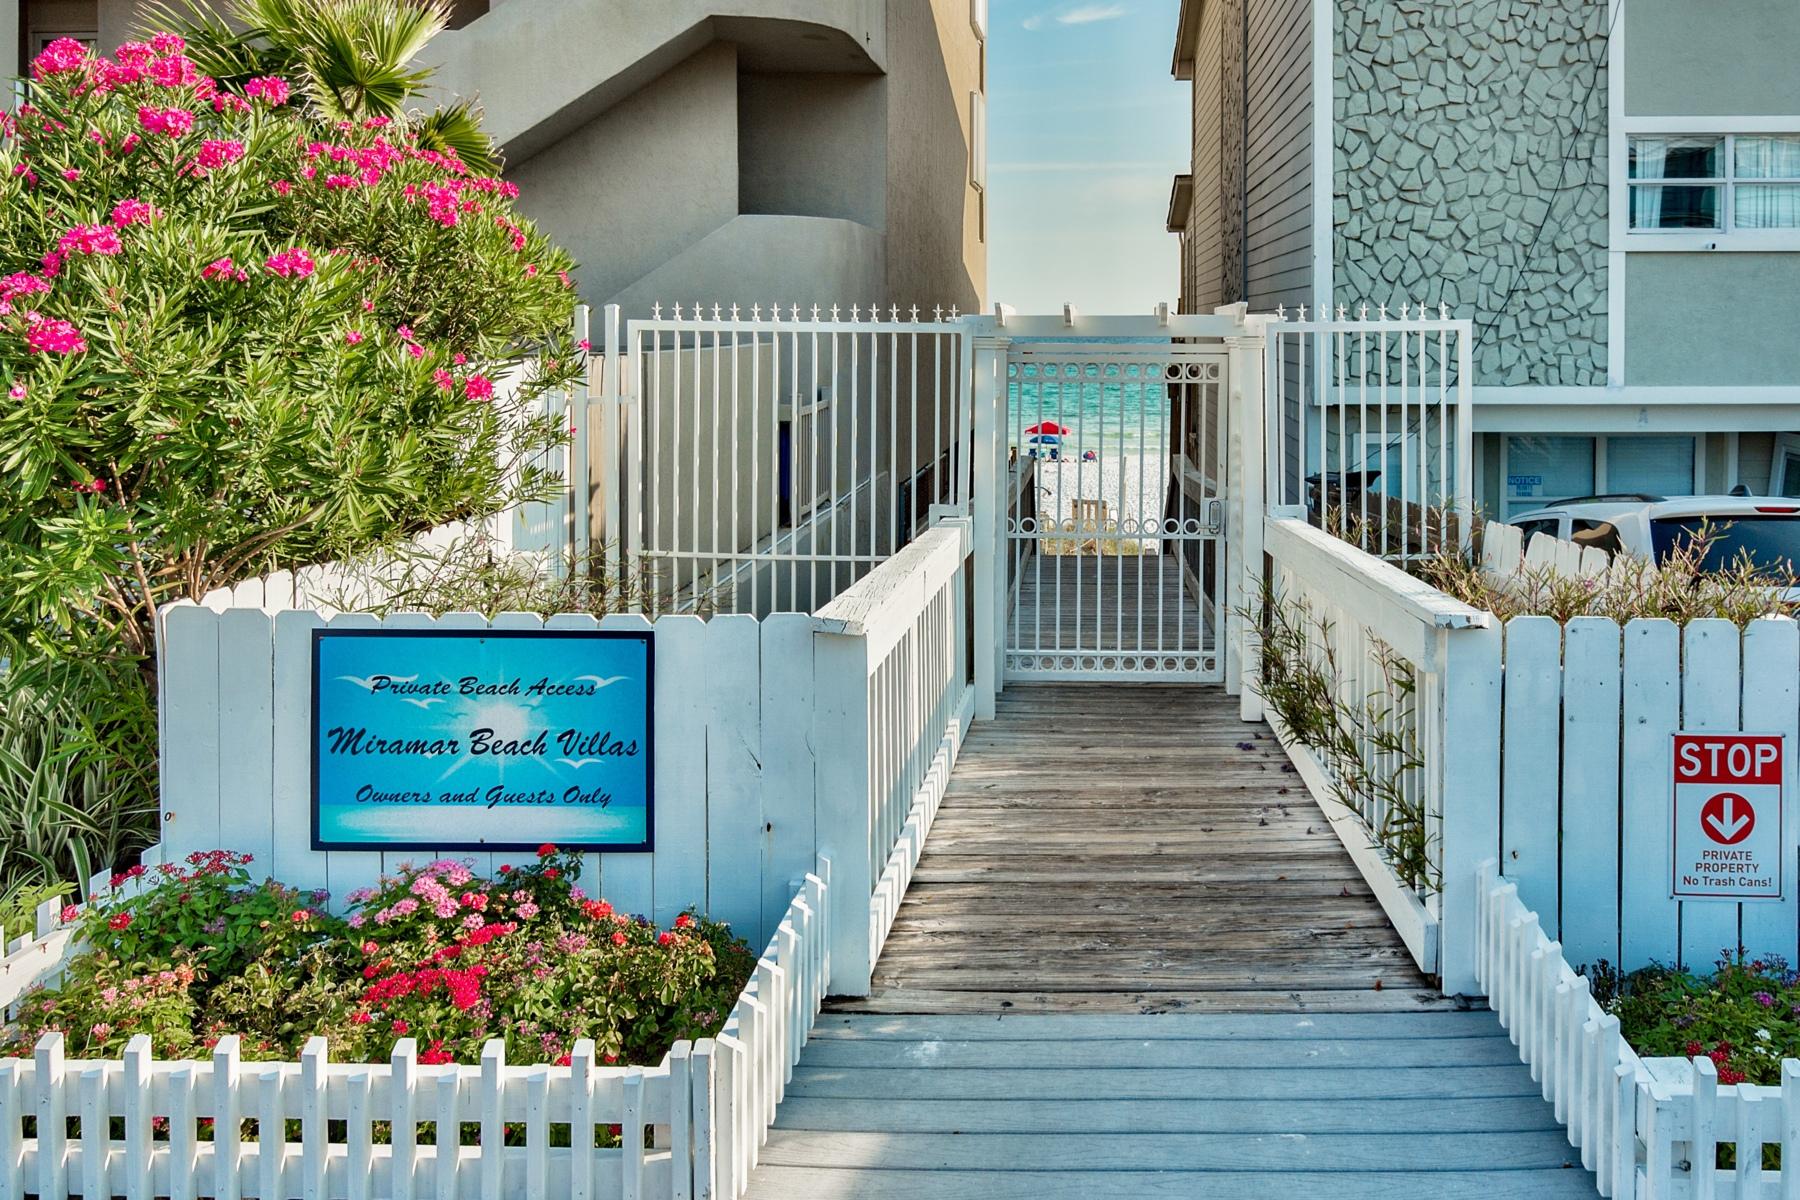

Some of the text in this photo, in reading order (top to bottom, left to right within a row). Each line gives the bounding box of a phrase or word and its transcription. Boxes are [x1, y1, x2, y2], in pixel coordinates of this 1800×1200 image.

[370, 675, 597, 697] Private Beach Access
[327, 726, 640, 757] Miramar Beach Villas
[1679, 742, 1778, 777] STOP
[355, 784, 613, 809] Owners and Guests Only
[1702, 850, 1753, 861] PRIVATE
[1695, 862, 1760, 873] PROPERTY
[1683, 875, 1772, 887] No Trash Cans!
